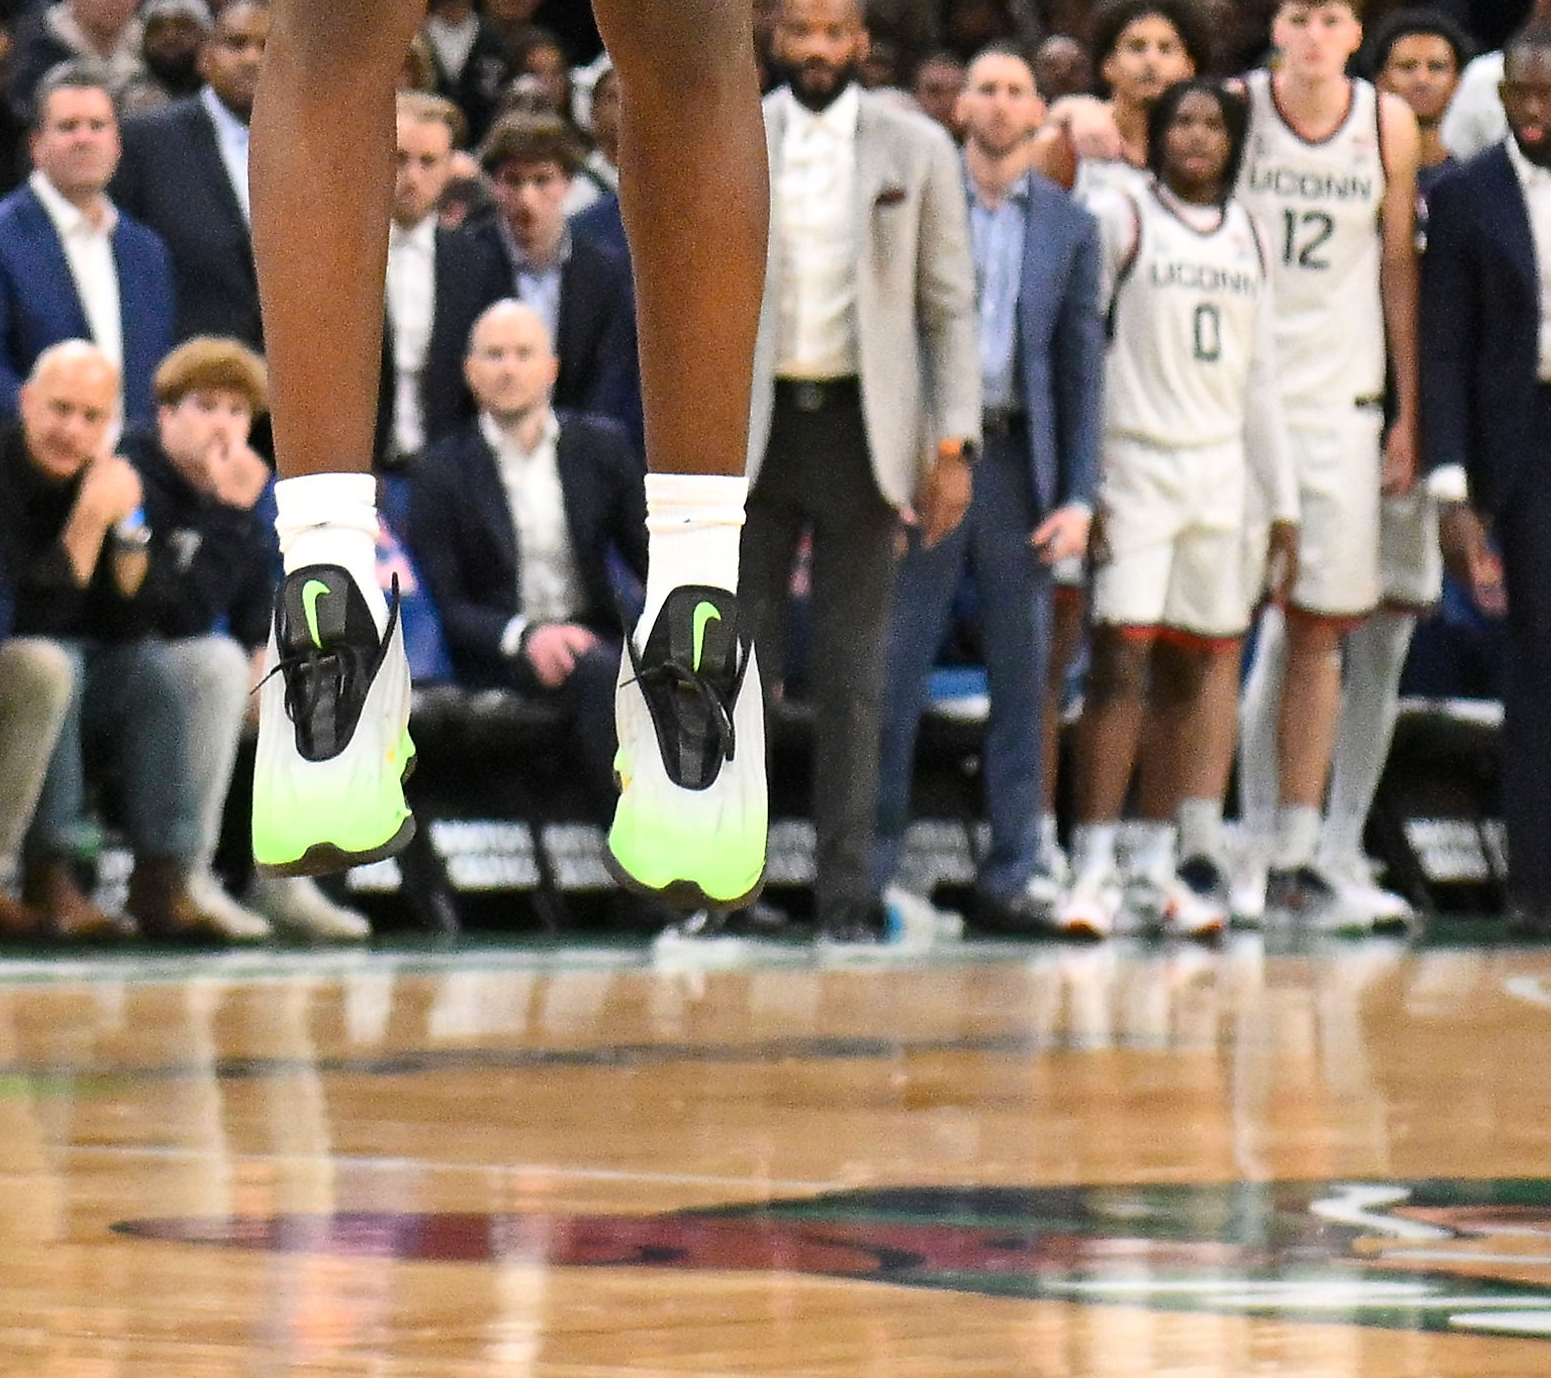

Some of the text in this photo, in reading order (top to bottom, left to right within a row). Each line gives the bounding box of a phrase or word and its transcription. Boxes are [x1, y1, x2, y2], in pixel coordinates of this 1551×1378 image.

[1248, 166, 1373, 201] UCONN
[1282, 208, 1335, 271] 12
[1192, 302, 1222, 363] 0
